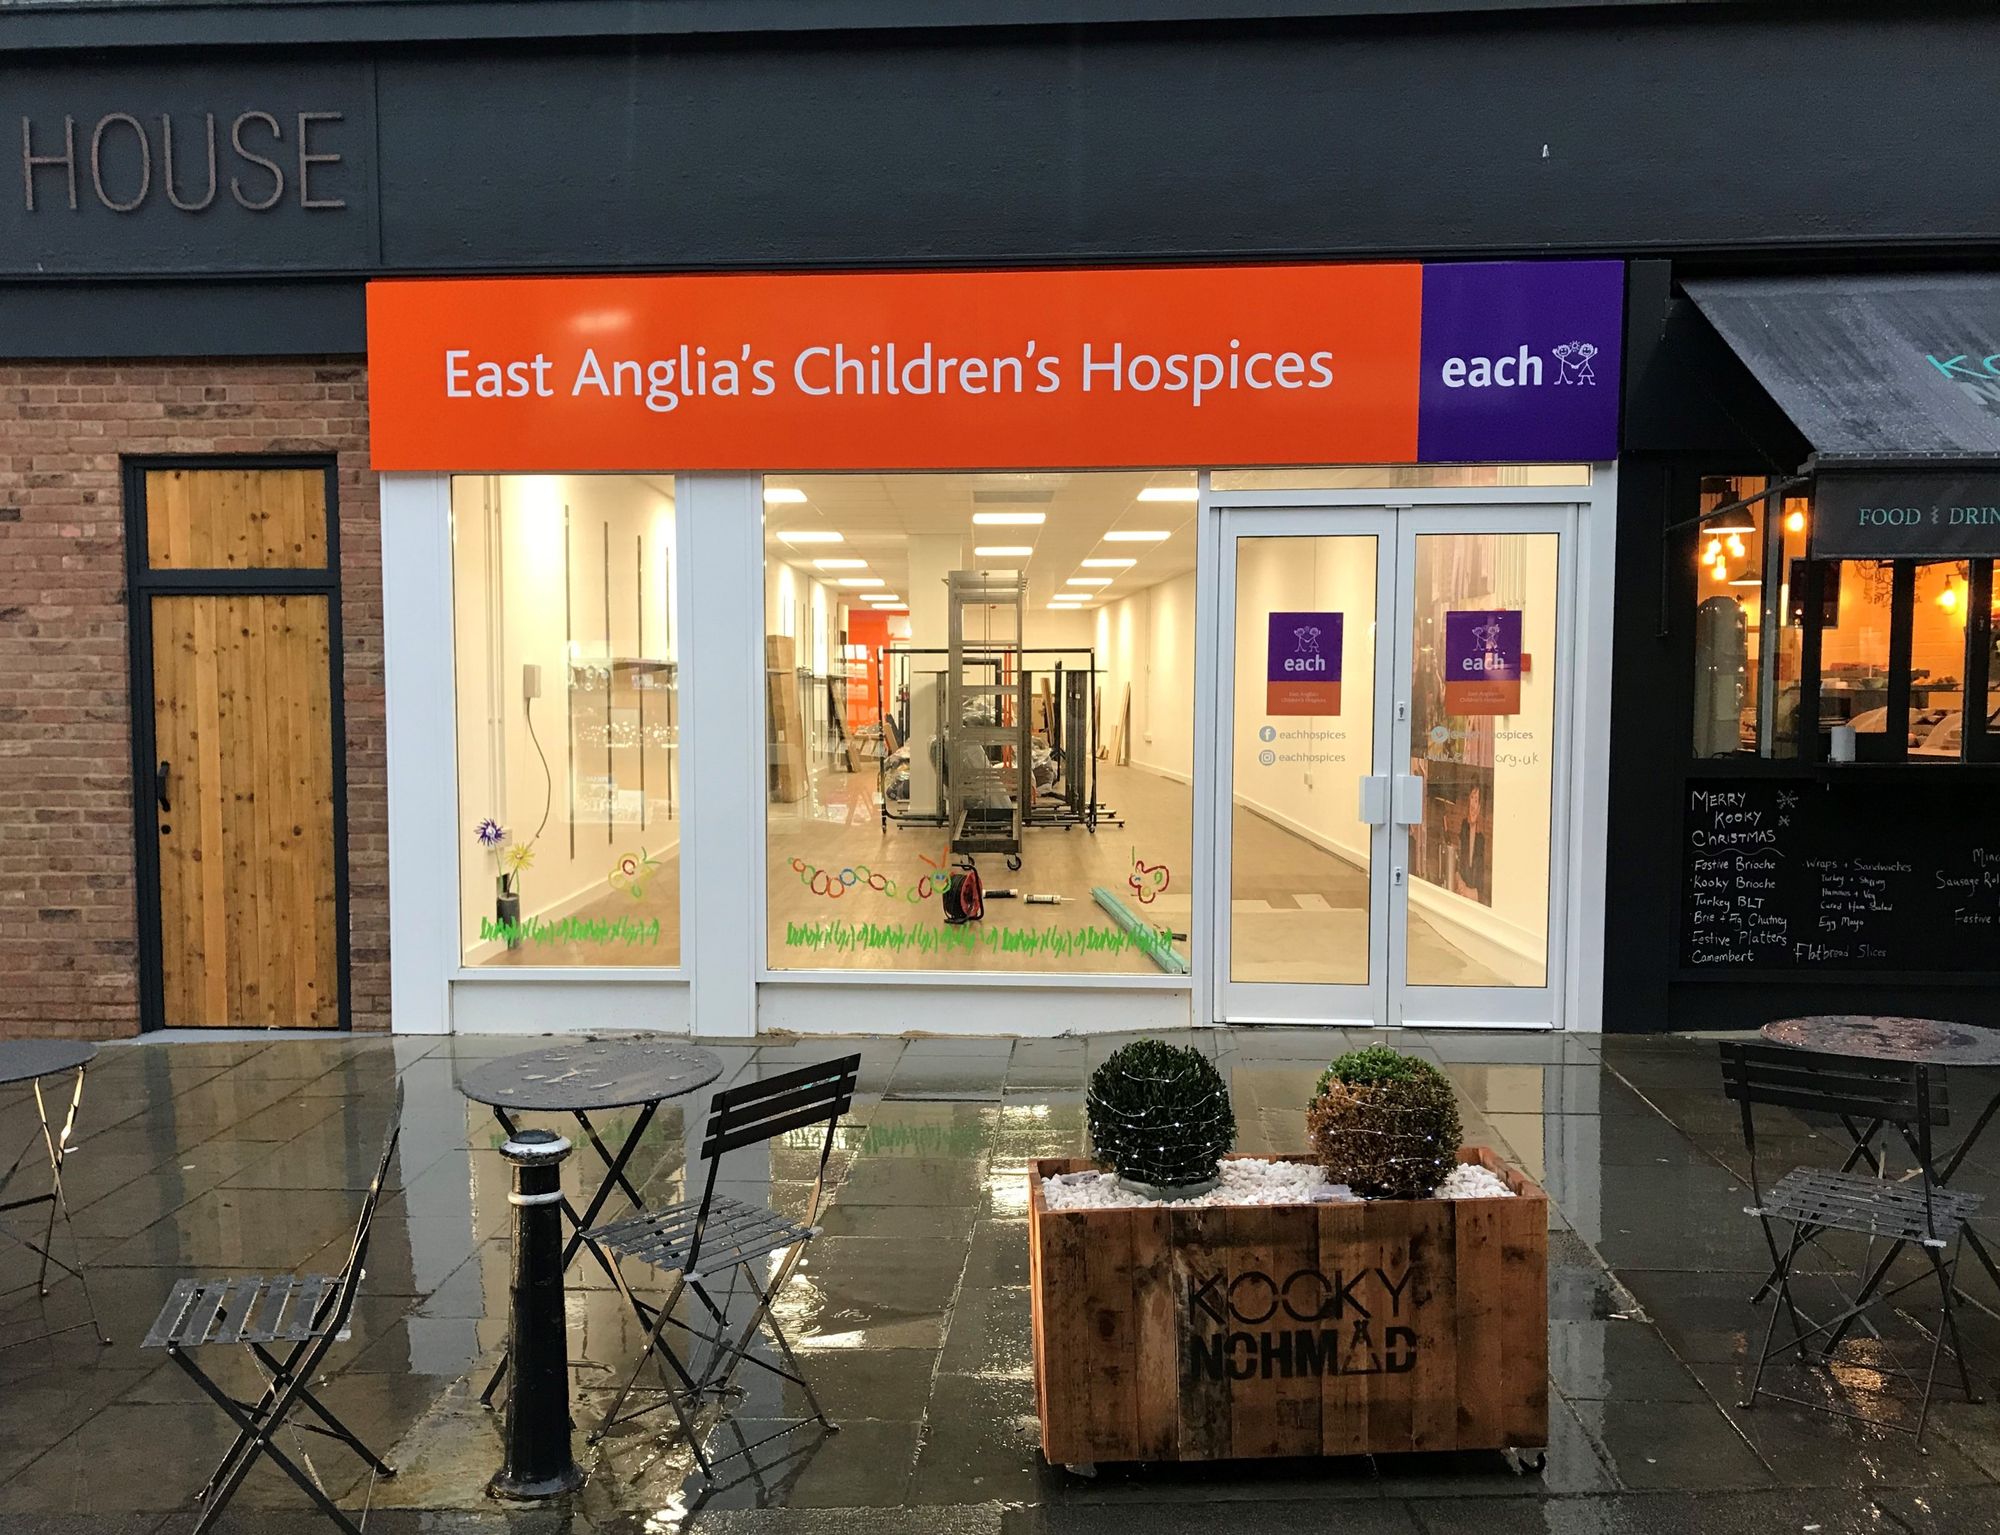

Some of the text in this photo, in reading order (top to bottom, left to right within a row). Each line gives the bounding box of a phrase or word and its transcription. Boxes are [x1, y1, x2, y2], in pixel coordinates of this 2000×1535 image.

[22, 111, 347, 212] HOUSE
[1441, 343, 1543, 388] each
[445, 338, 1334, 413] East Anglia’s Children’s Hospices
[1858, 507, 1921, 526] FOOD
[1284, 654, 1326, 672] each
[1462, 653, 1504, 671] each
[1278, 728, 1347, 742] eachhospices
[1278, 752, 1346, 766] eachhospices
[1691, 790, 1747, 813] MERRY
[1694, 856, 1777, 872] Festive Brioche
[1806, 858, 1838, 872] Wraps
[1853, 858, 1912, 873] Sandwiches
[1693, 876, 1777, 893] Kooky Brioche
[1935, 869, 1980, 897] Sausage
[1693, 893, 1766, 914] Turkey BLT
[1693, 910, 1716, 925] Brie
[1747, 912, 1787, 935] Chutney
[1818, 915, 1865, 932] Egg Mayo
[1954, 906, 1992, 926] Festive
[1691, 930, 1788, 947] Festive Platters
[1691, 949, 1755, 964] Camembert
[1187, 1268, 1414, 1325] KOOKY
